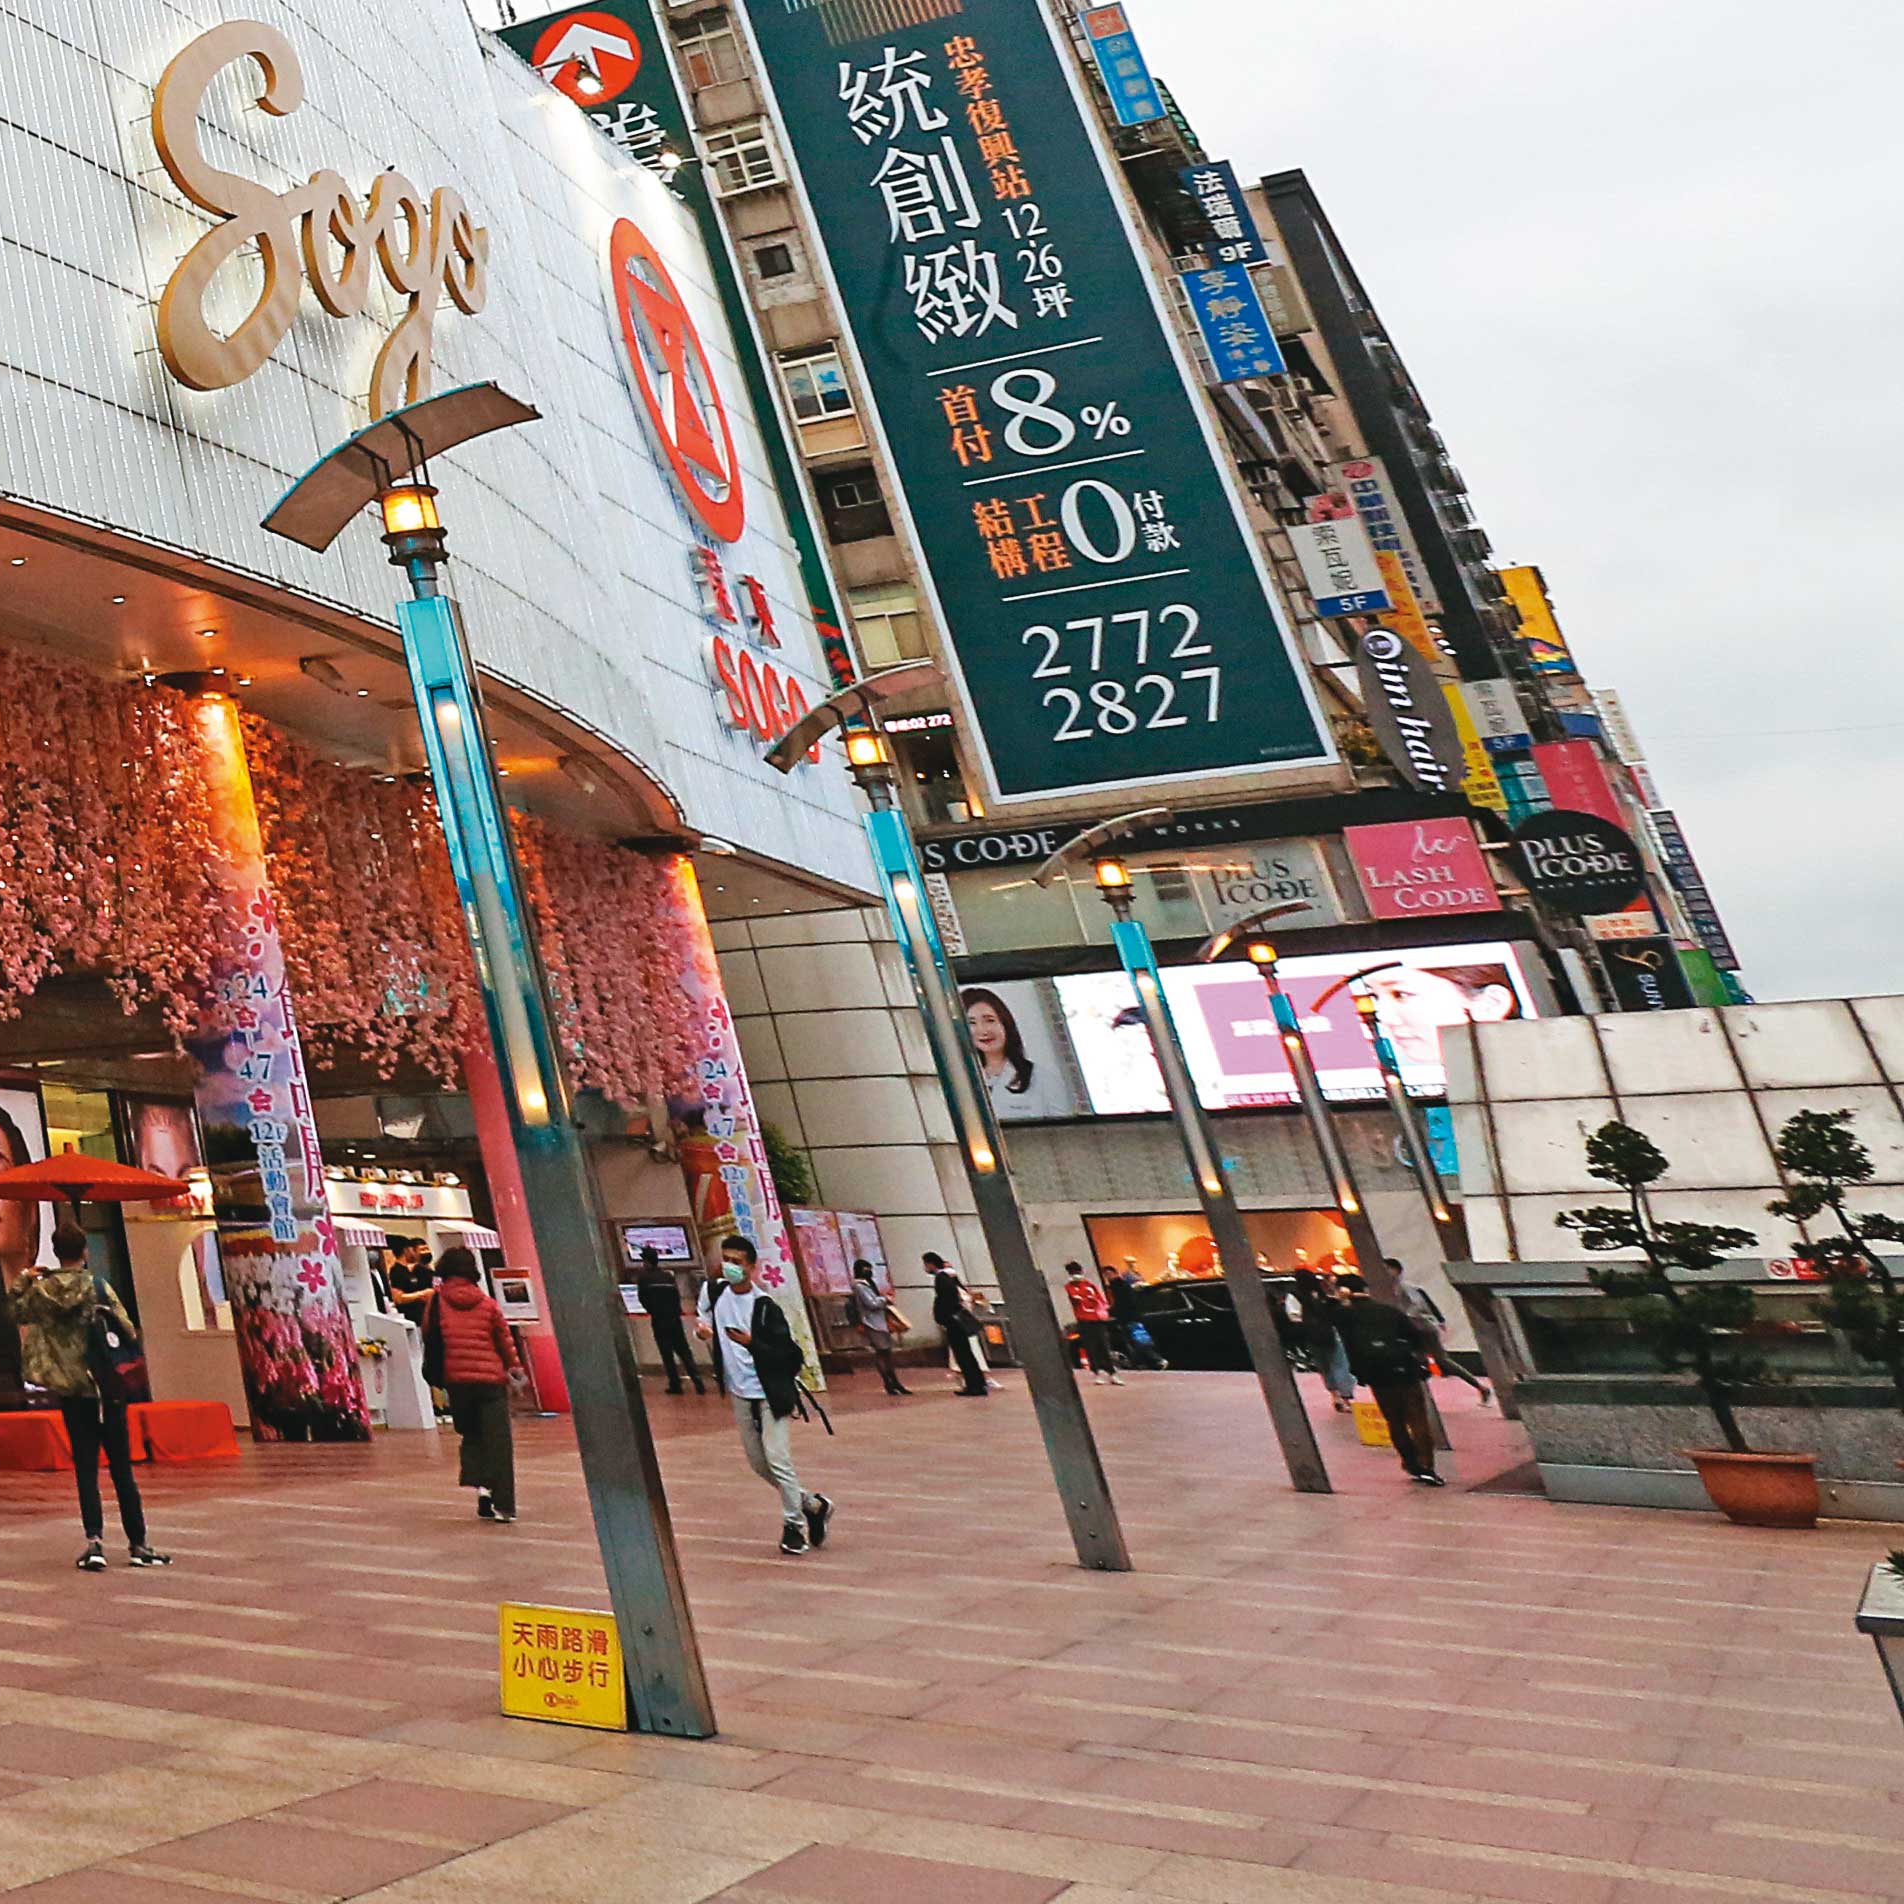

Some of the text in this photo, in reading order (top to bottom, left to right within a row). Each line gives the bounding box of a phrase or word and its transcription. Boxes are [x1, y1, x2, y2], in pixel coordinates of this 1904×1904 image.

[944, 36, 1032, 199] 忠孝復興站
[839, 47, 1018, 344] 統創緻
[152, 19, 488, 422] Sogo
[1218, 241, 1253, 263] 9F
[936, 368, 1131, 467] 首付 8%
[1060, 479, 1136, 564] 0
[1132, 491, 1181, 553] 付款
[1341, 595, 1369, 612] 5F
[1022, 604, 1212, 679] 2772
[1042, 667, 1220, 742] 2827
[954, 830, 1058, 864] CODE
[1542, 851, 1635, 878] CODE
[1227, 876, 1318, 905] CODE
[1365, 865, 1456, 889] LASH
[1394, 887, 1489, 910] CODE
[512, 1621, 609, 1656] 天雨路滑
[512, 1653, 611, 1688] 小心步行
